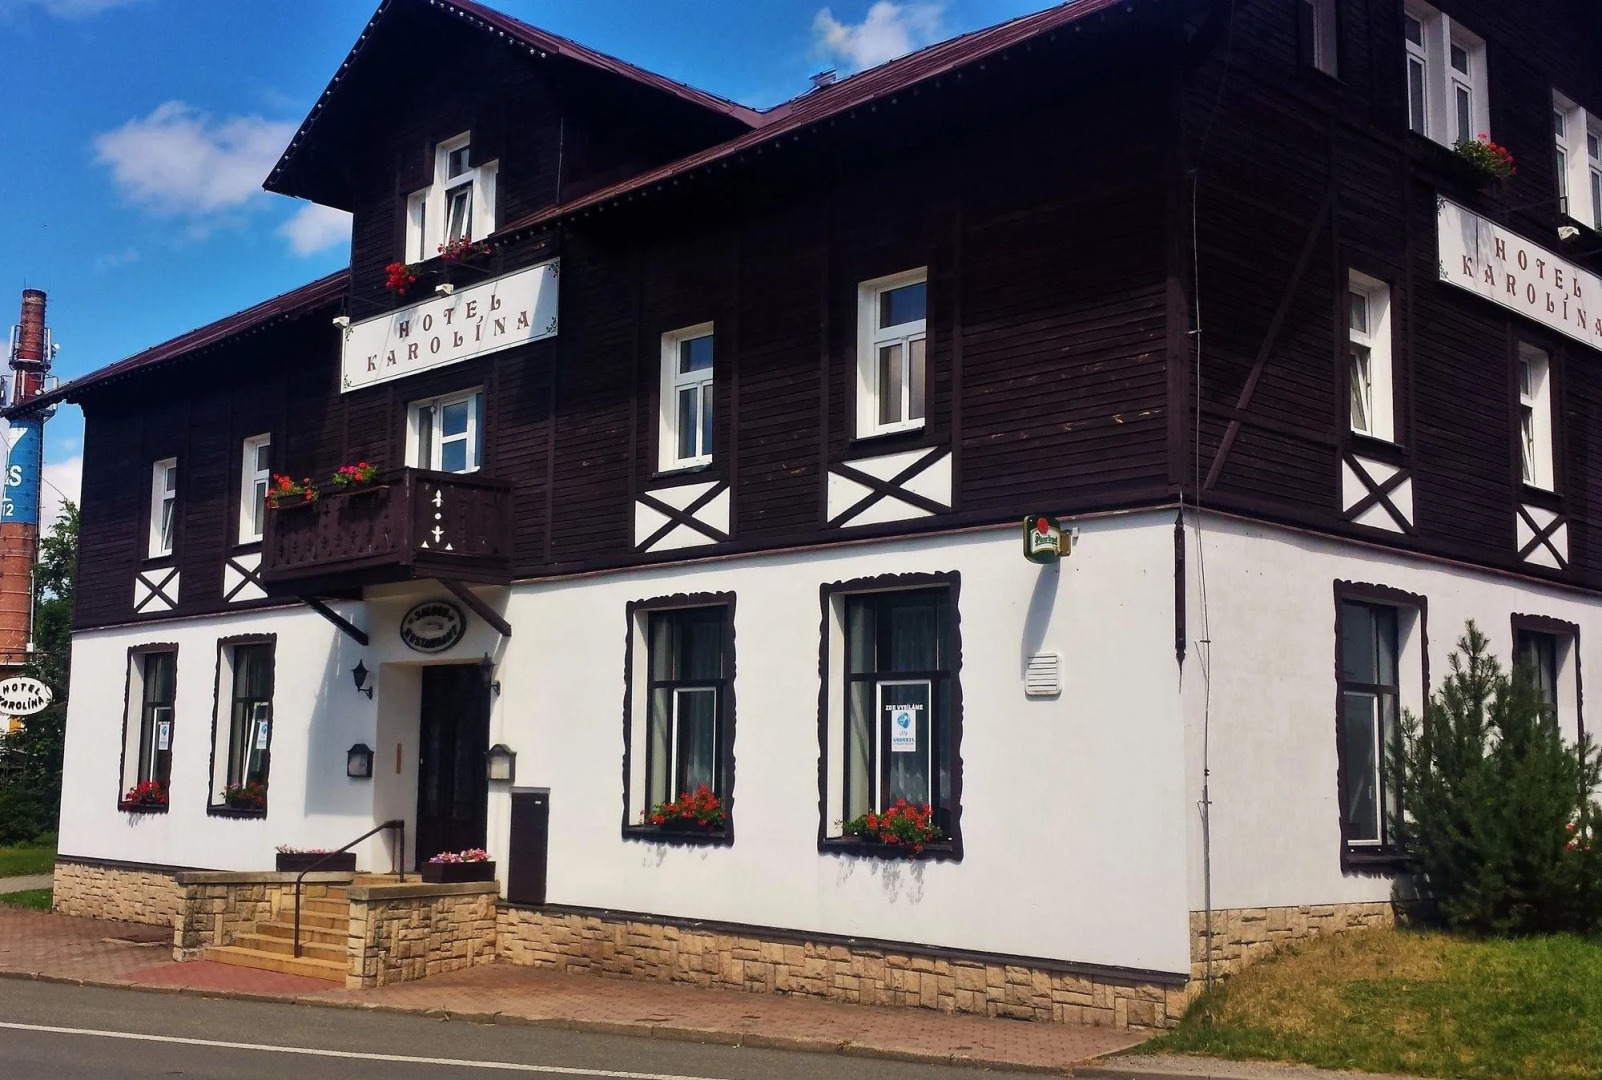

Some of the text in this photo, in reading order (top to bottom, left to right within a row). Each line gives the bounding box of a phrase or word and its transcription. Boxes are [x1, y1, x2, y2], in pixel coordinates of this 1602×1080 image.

[1495, 236, 1582, 298] HOTEL
[366, 310, 530, 372] KAROLÍNA
[398, 294, 501, 339] HOTEL
[2, 682, 41, 696] HOTEL
